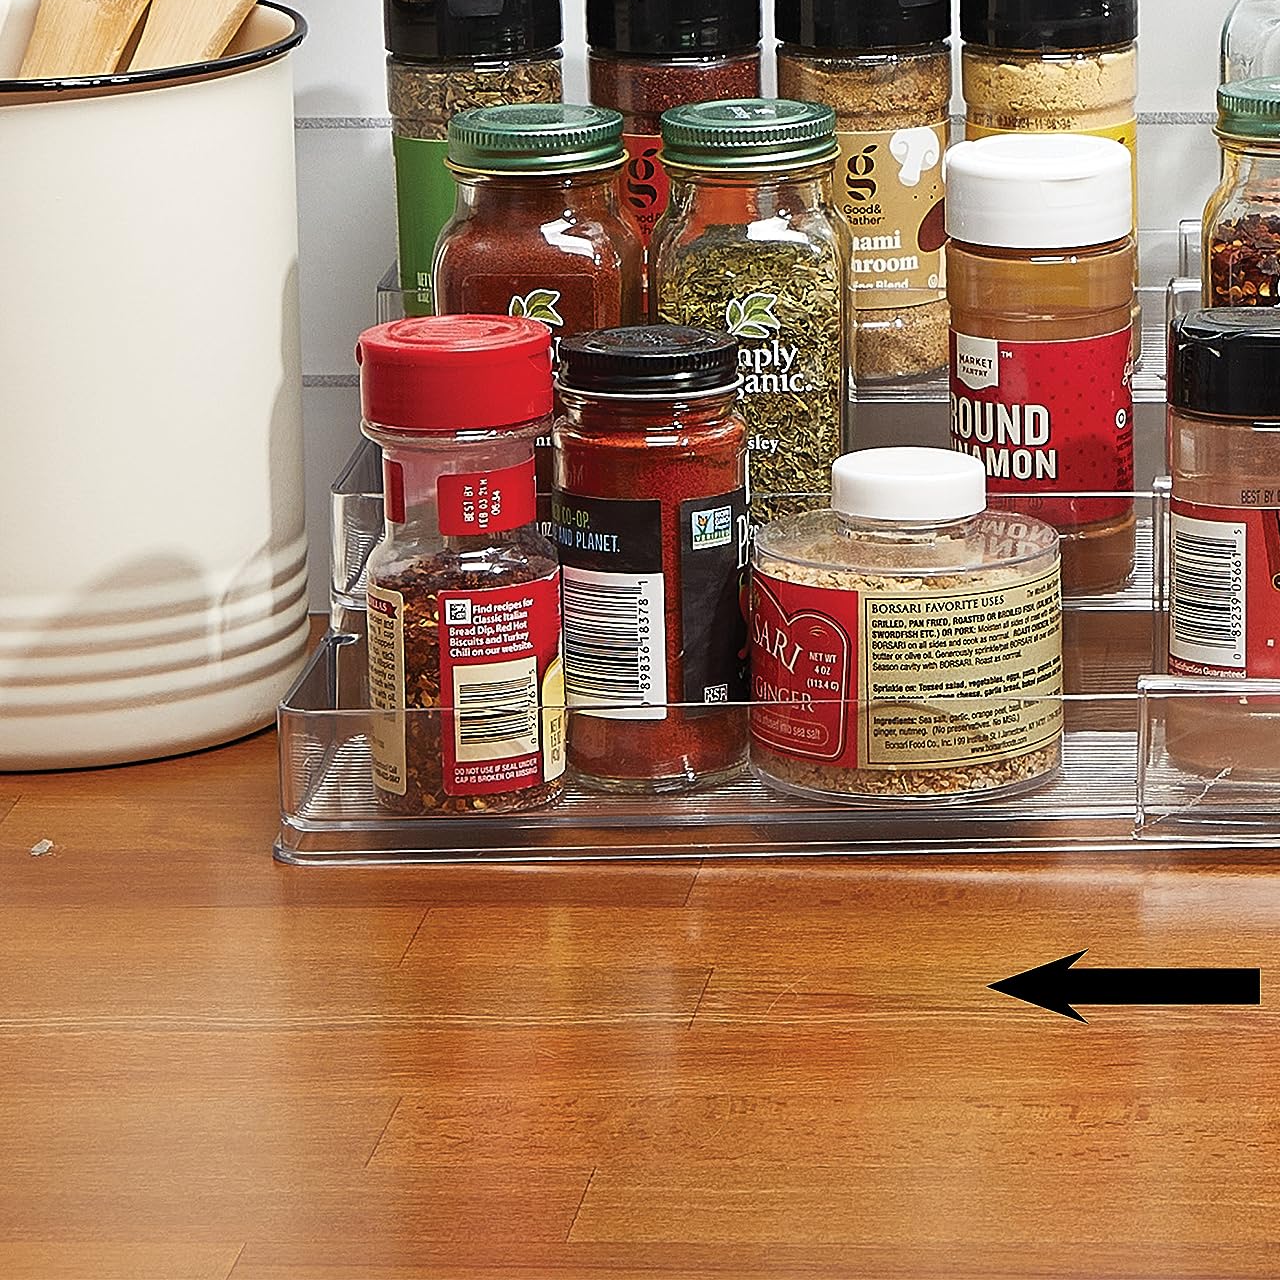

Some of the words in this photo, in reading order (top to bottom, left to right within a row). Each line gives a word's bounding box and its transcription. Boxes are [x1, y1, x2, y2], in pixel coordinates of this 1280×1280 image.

[958, 352, 993, 370] MARKET
[962, 365, 988, 377] PANTRY
[950, 391, 1050, 446] ROUND
[746, 433, 779, 454] sley
[1241, 489, 1261, 504] BEST
[1263, 489, 1276, 504] BY
[576, 531, 621, 553] PLANET.
[473, 603, 493, 615] Find
[494, 600, 523, 612] recipes
[523, 598, 534, 608] for
[872, 603, 921, 614] BORSARI
[925, 599, 979, 614] FAVORITE
[981, 594, 1004, 608] USES
[472, 615, 503, 625] Classic
[503, 611, 528, 621] Italian
[872, 619, 907, 629] GRILLED,
[908, 619, 925, 628] PAN
[953, 613, 986, 626] ROASTED
[986, 611, 997, 621] OR
[449, 627, 476, 637] Bread
[477, 624, 495, 635] Dip,
[496, 623, 512, 634] Red
[513, 621, 528, 631] Hot
[872, 630, 919, 639] SWORDFISH
[919, 629, 941, 639] ETC.)
[942, 628, 953, 637] OR
[449, 637, 484, 648] Biscuits
[485, 635, 502, 645] and
[503, 631, 530, 643] Turkey
[471, 646, 484, 655] on
[485, 645, 501, 654] our
[501, 640, 534, 652] website.
[752, 613, 804, 675] SARI
[872, 640, 907, 650] BORSARI
[907, 642, 918, 650] on
[948, 637, 962, 648] and
[963, 636, 979, 646] cook
[809, 652, 823, 663] NET
[824, 654, 838, 664] WT
[755, 675, 815, 713] GINGER
[908, 738, 926, 749] Food
[455, 768, 465, 776] DO
[466, 766, 480, 775] NOT
[480, 765, 493, 774] USE
[502, 762, 519, 772] SEAL
[455, 775, 470, 784] CAP
[478, 771, 505, 782] BROKEN
[505, 768, 516, 778] OR
